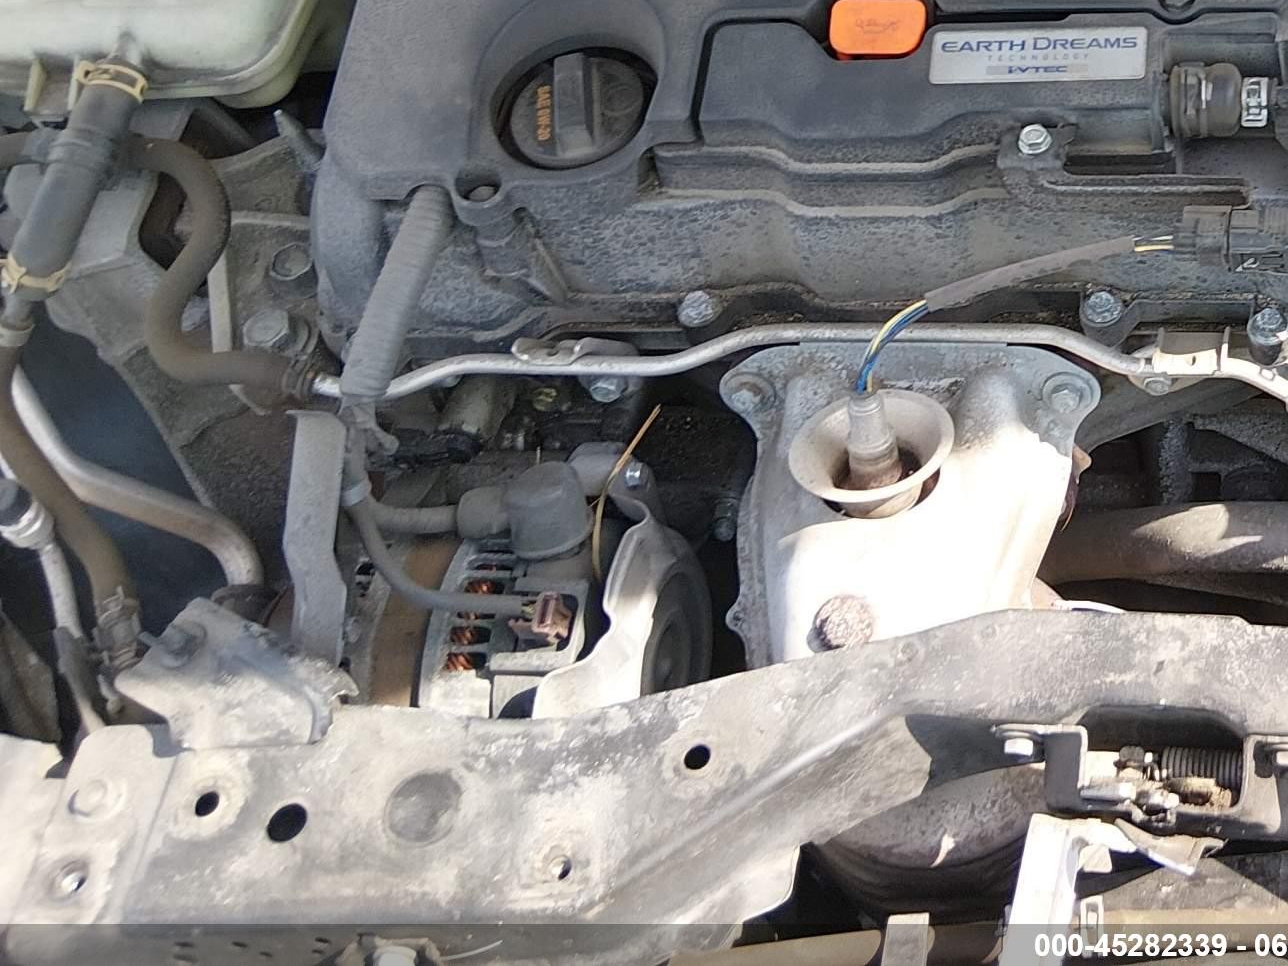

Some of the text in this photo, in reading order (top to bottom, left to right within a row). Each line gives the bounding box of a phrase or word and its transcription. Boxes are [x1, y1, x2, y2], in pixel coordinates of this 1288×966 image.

[941, 36, 1138, 53] EARTH DREAMS
[987, 53, 1089, 62] TECHNOLOGY
